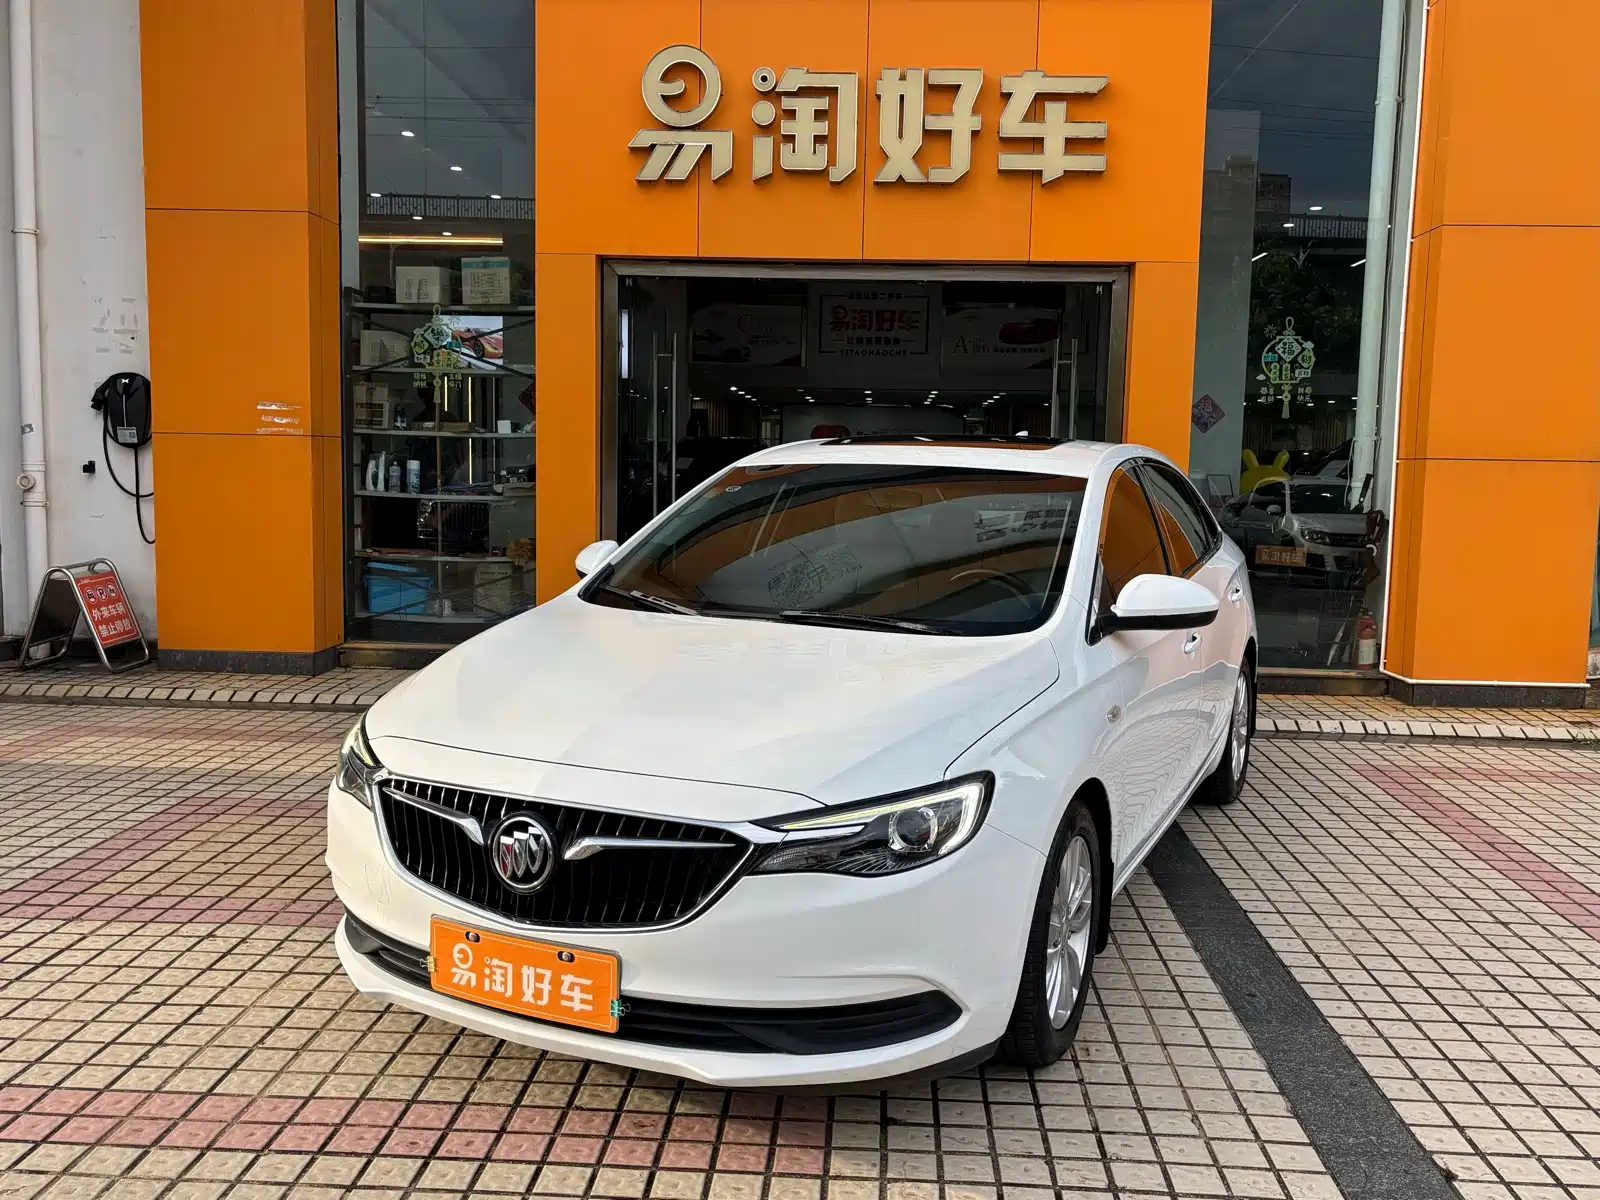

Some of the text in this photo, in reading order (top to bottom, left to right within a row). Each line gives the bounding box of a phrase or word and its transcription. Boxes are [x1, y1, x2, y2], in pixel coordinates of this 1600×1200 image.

[627, 43, 1111, 187] 易淘好车
[829, 304, 921, 331] 易淘好车
[1280, 341, 1296, 356] 福
[91, 602, 126, 621] 外来车辆
[98, 618, 133, 638] 禁止停放
[449, 942, 594, 1013] 易淘好车
